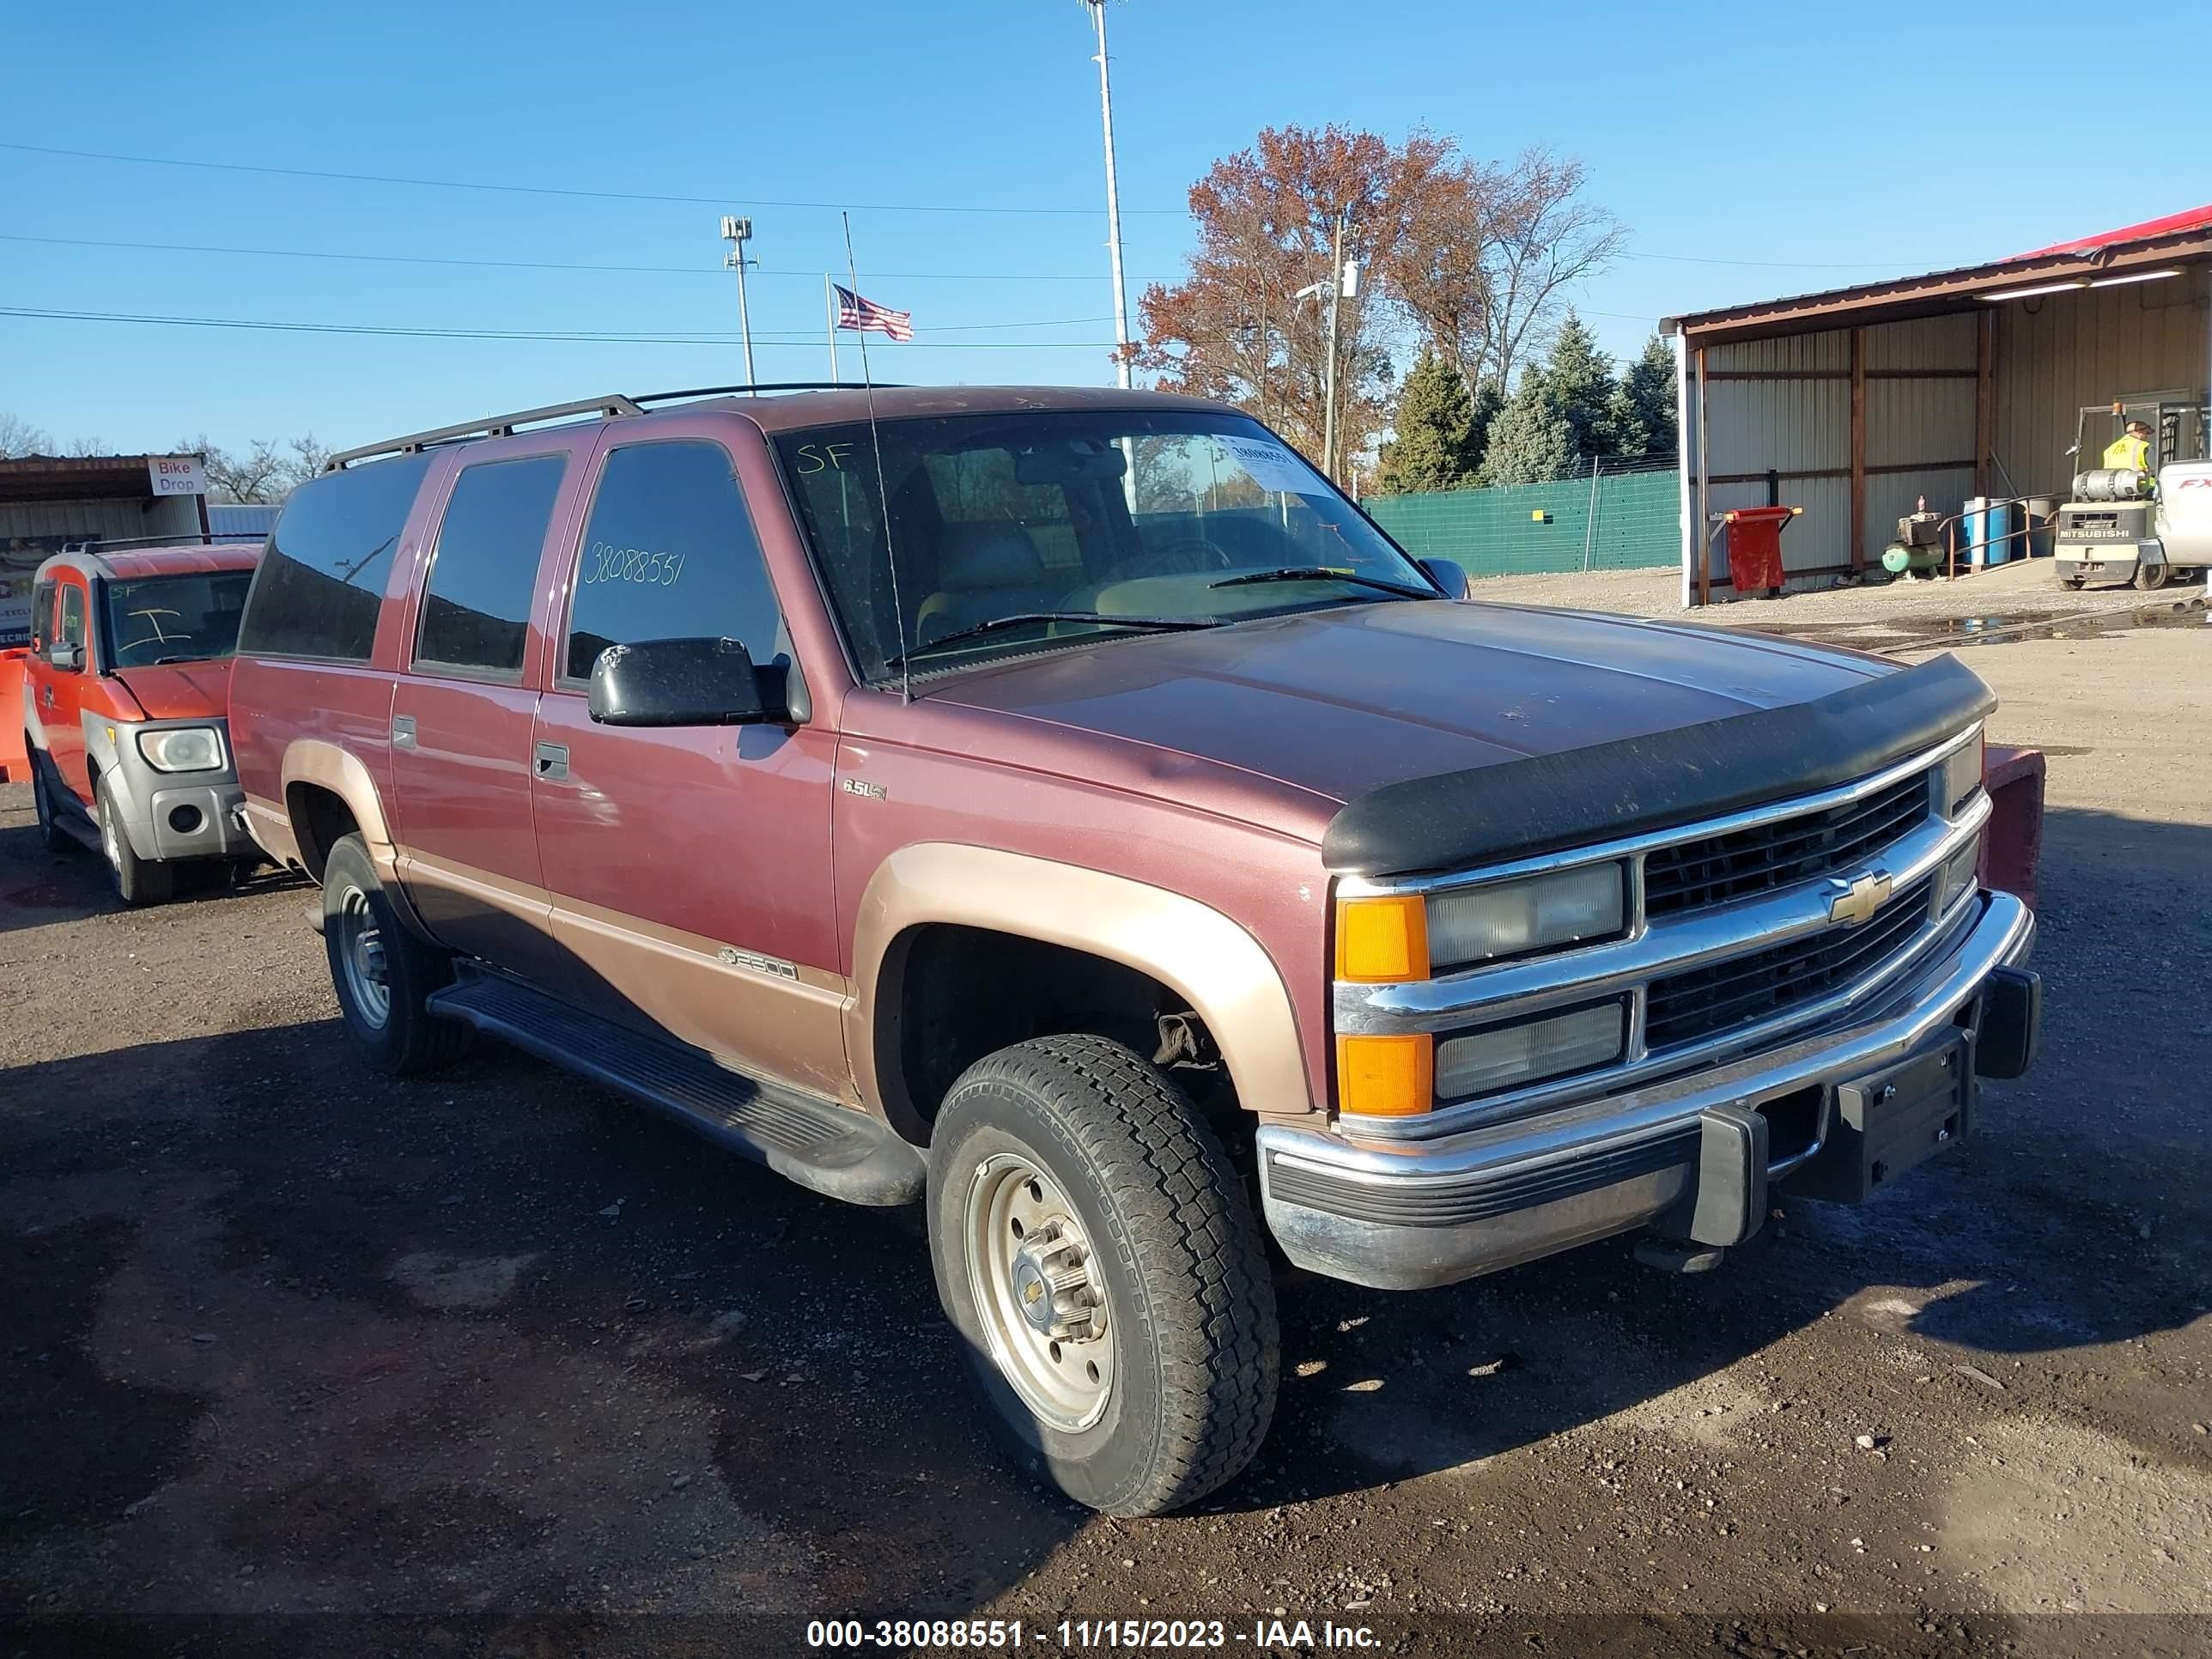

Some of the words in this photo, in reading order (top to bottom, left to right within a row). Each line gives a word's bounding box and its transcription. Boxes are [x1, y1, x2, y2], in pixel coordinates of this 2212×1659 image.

[797, 443, 854, 474] SF
[1232, 447, 1293, 465] 38088551
[159, 462, 191, 474] Bike
[161, 478, 195, 492] Drop
[2060, 530, 2130, 538] MITSUBISHI
[585, 541, 686, 586] 38088551
[736, 951, 799, 981] 2500
